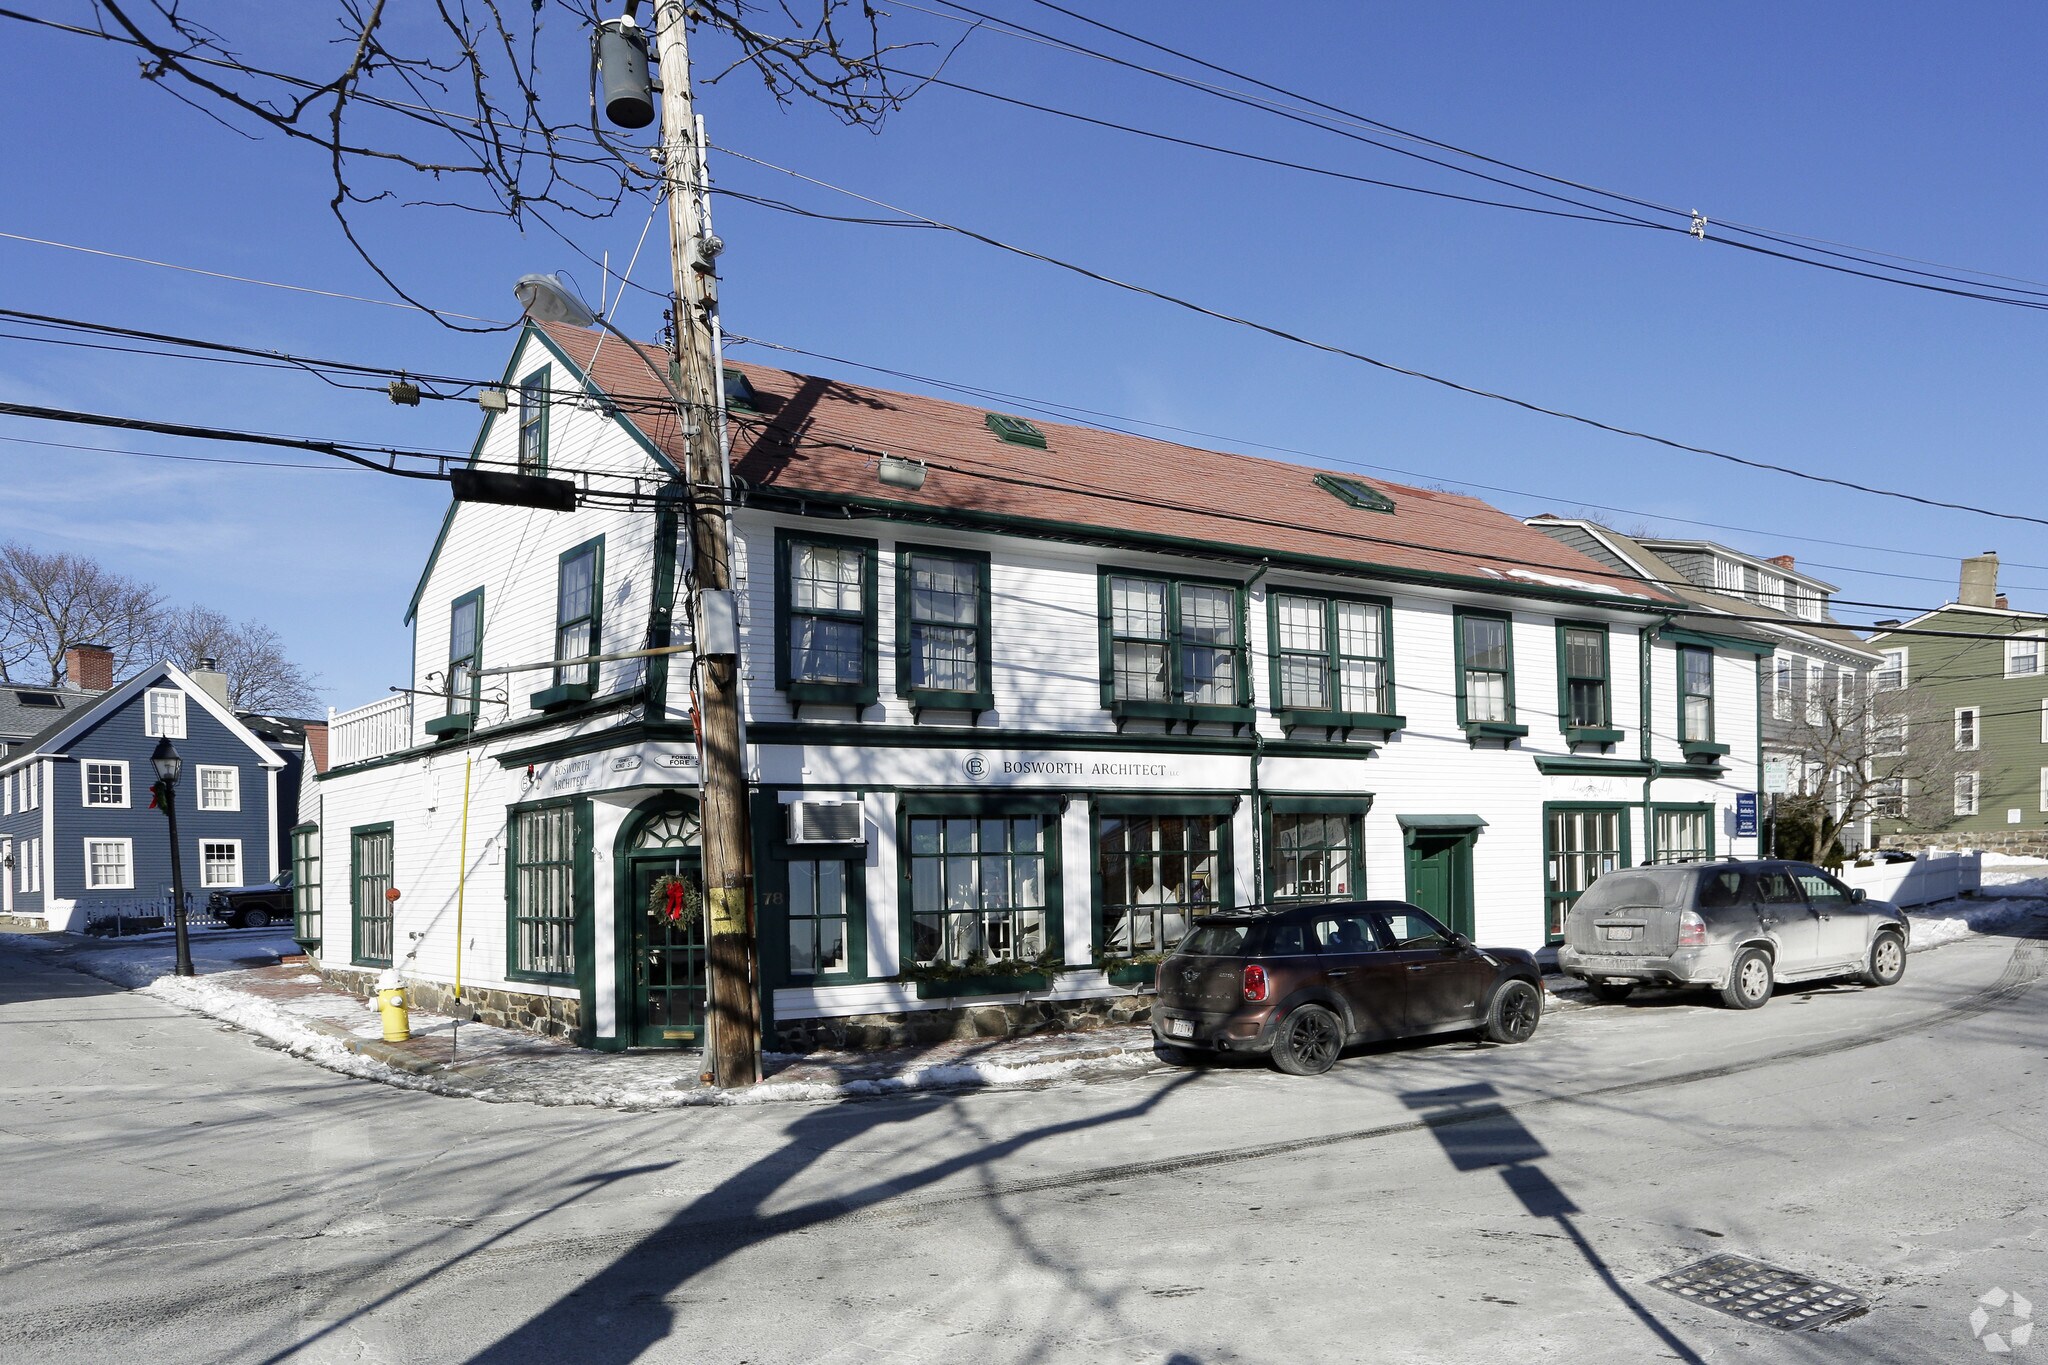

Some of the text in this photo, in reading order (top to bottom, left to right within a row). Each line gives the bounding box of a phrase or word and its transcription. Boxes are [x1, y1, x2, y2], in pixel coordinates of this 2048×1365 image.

[554, 759, 591, 777] BOSWORTH
[1003, 761, 1083, 775] BOSWORTH
[1091, 763, 1167, 776] ARCHITECT
[553, 775, 589, 791] ARCHITECT
[763, 892, 784, 906] 78
